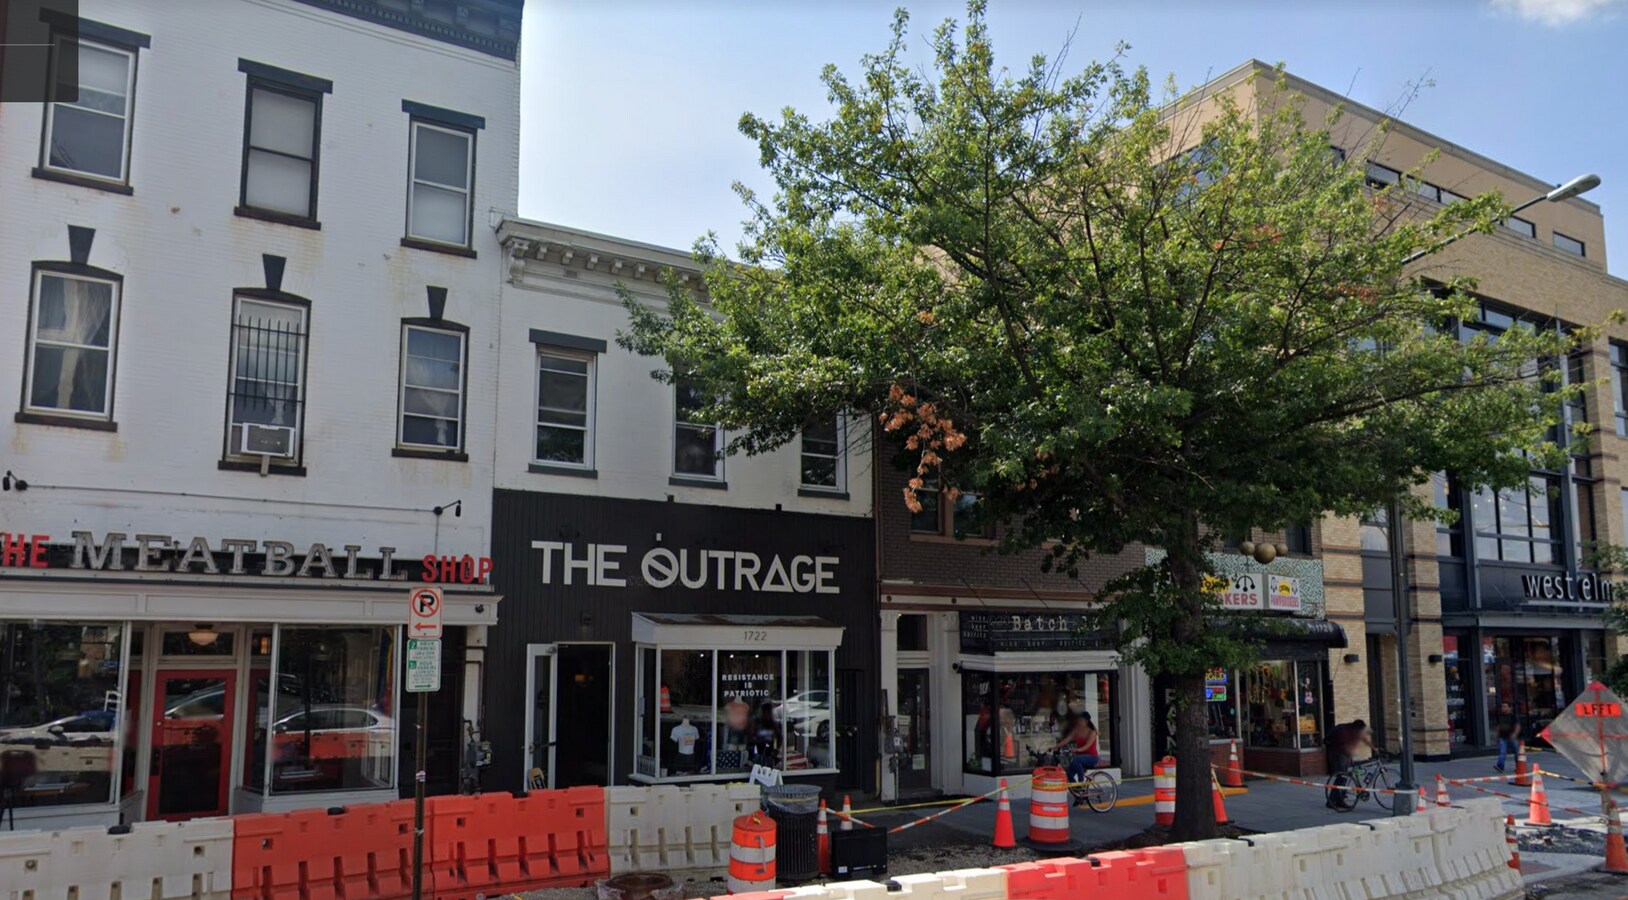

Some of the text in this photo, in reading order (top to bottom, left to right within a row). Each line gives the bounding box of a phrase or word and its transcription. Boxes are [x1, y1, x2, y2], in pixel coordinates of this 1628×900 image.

[0, 531, 494, 584] HE MEATBALL SHOP
[531, 540, 840, 594] THE OUTRAGE
[1526, 570, 1616, 601] west elm
[744, 631, 767, 641] 1722
[1012, 615, 1068, 631] Batch
